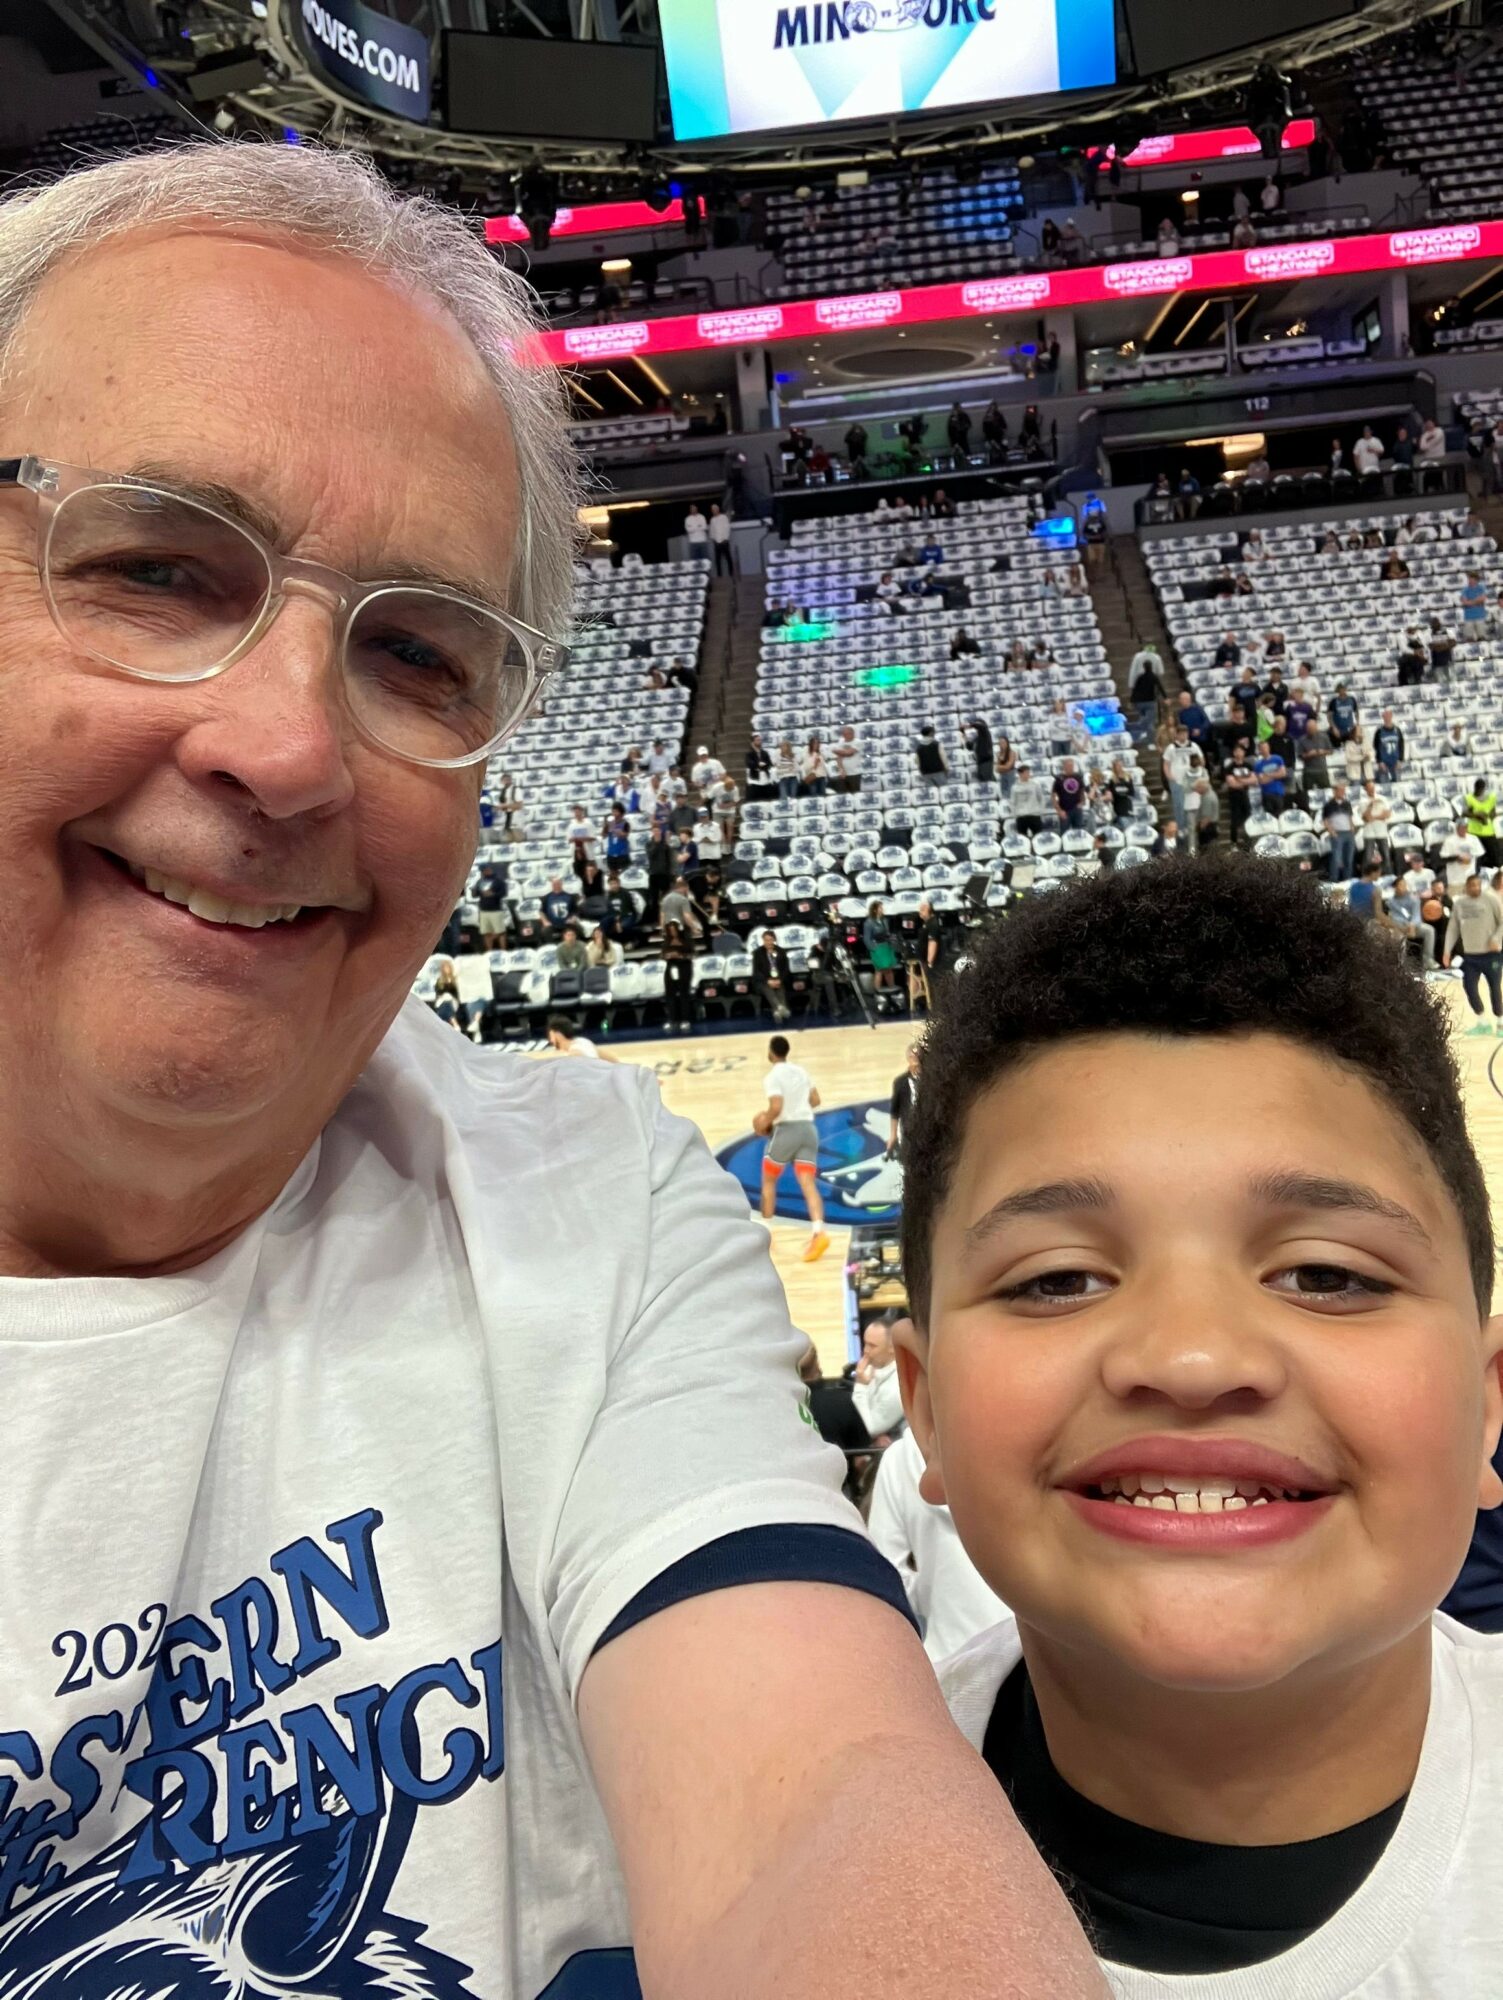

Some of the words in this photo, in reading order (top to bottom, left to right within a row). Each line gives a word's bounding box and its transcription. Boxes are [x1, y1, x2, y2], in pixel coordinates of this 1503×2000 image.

[773, 1, 850, 49] MIN
[1395, 230, 1476, 249] STANDARD
[1250, 247, 1329, 265] STANDARD
[1109, 263, 1187, 281] STANDARD
[968, 280, 1044, 298] STANDARD
[820, 297, 896, 316] STANDARD
[702, 313, 778, 331] STANDARD
[569, 328, 643, 345] STANDARD
